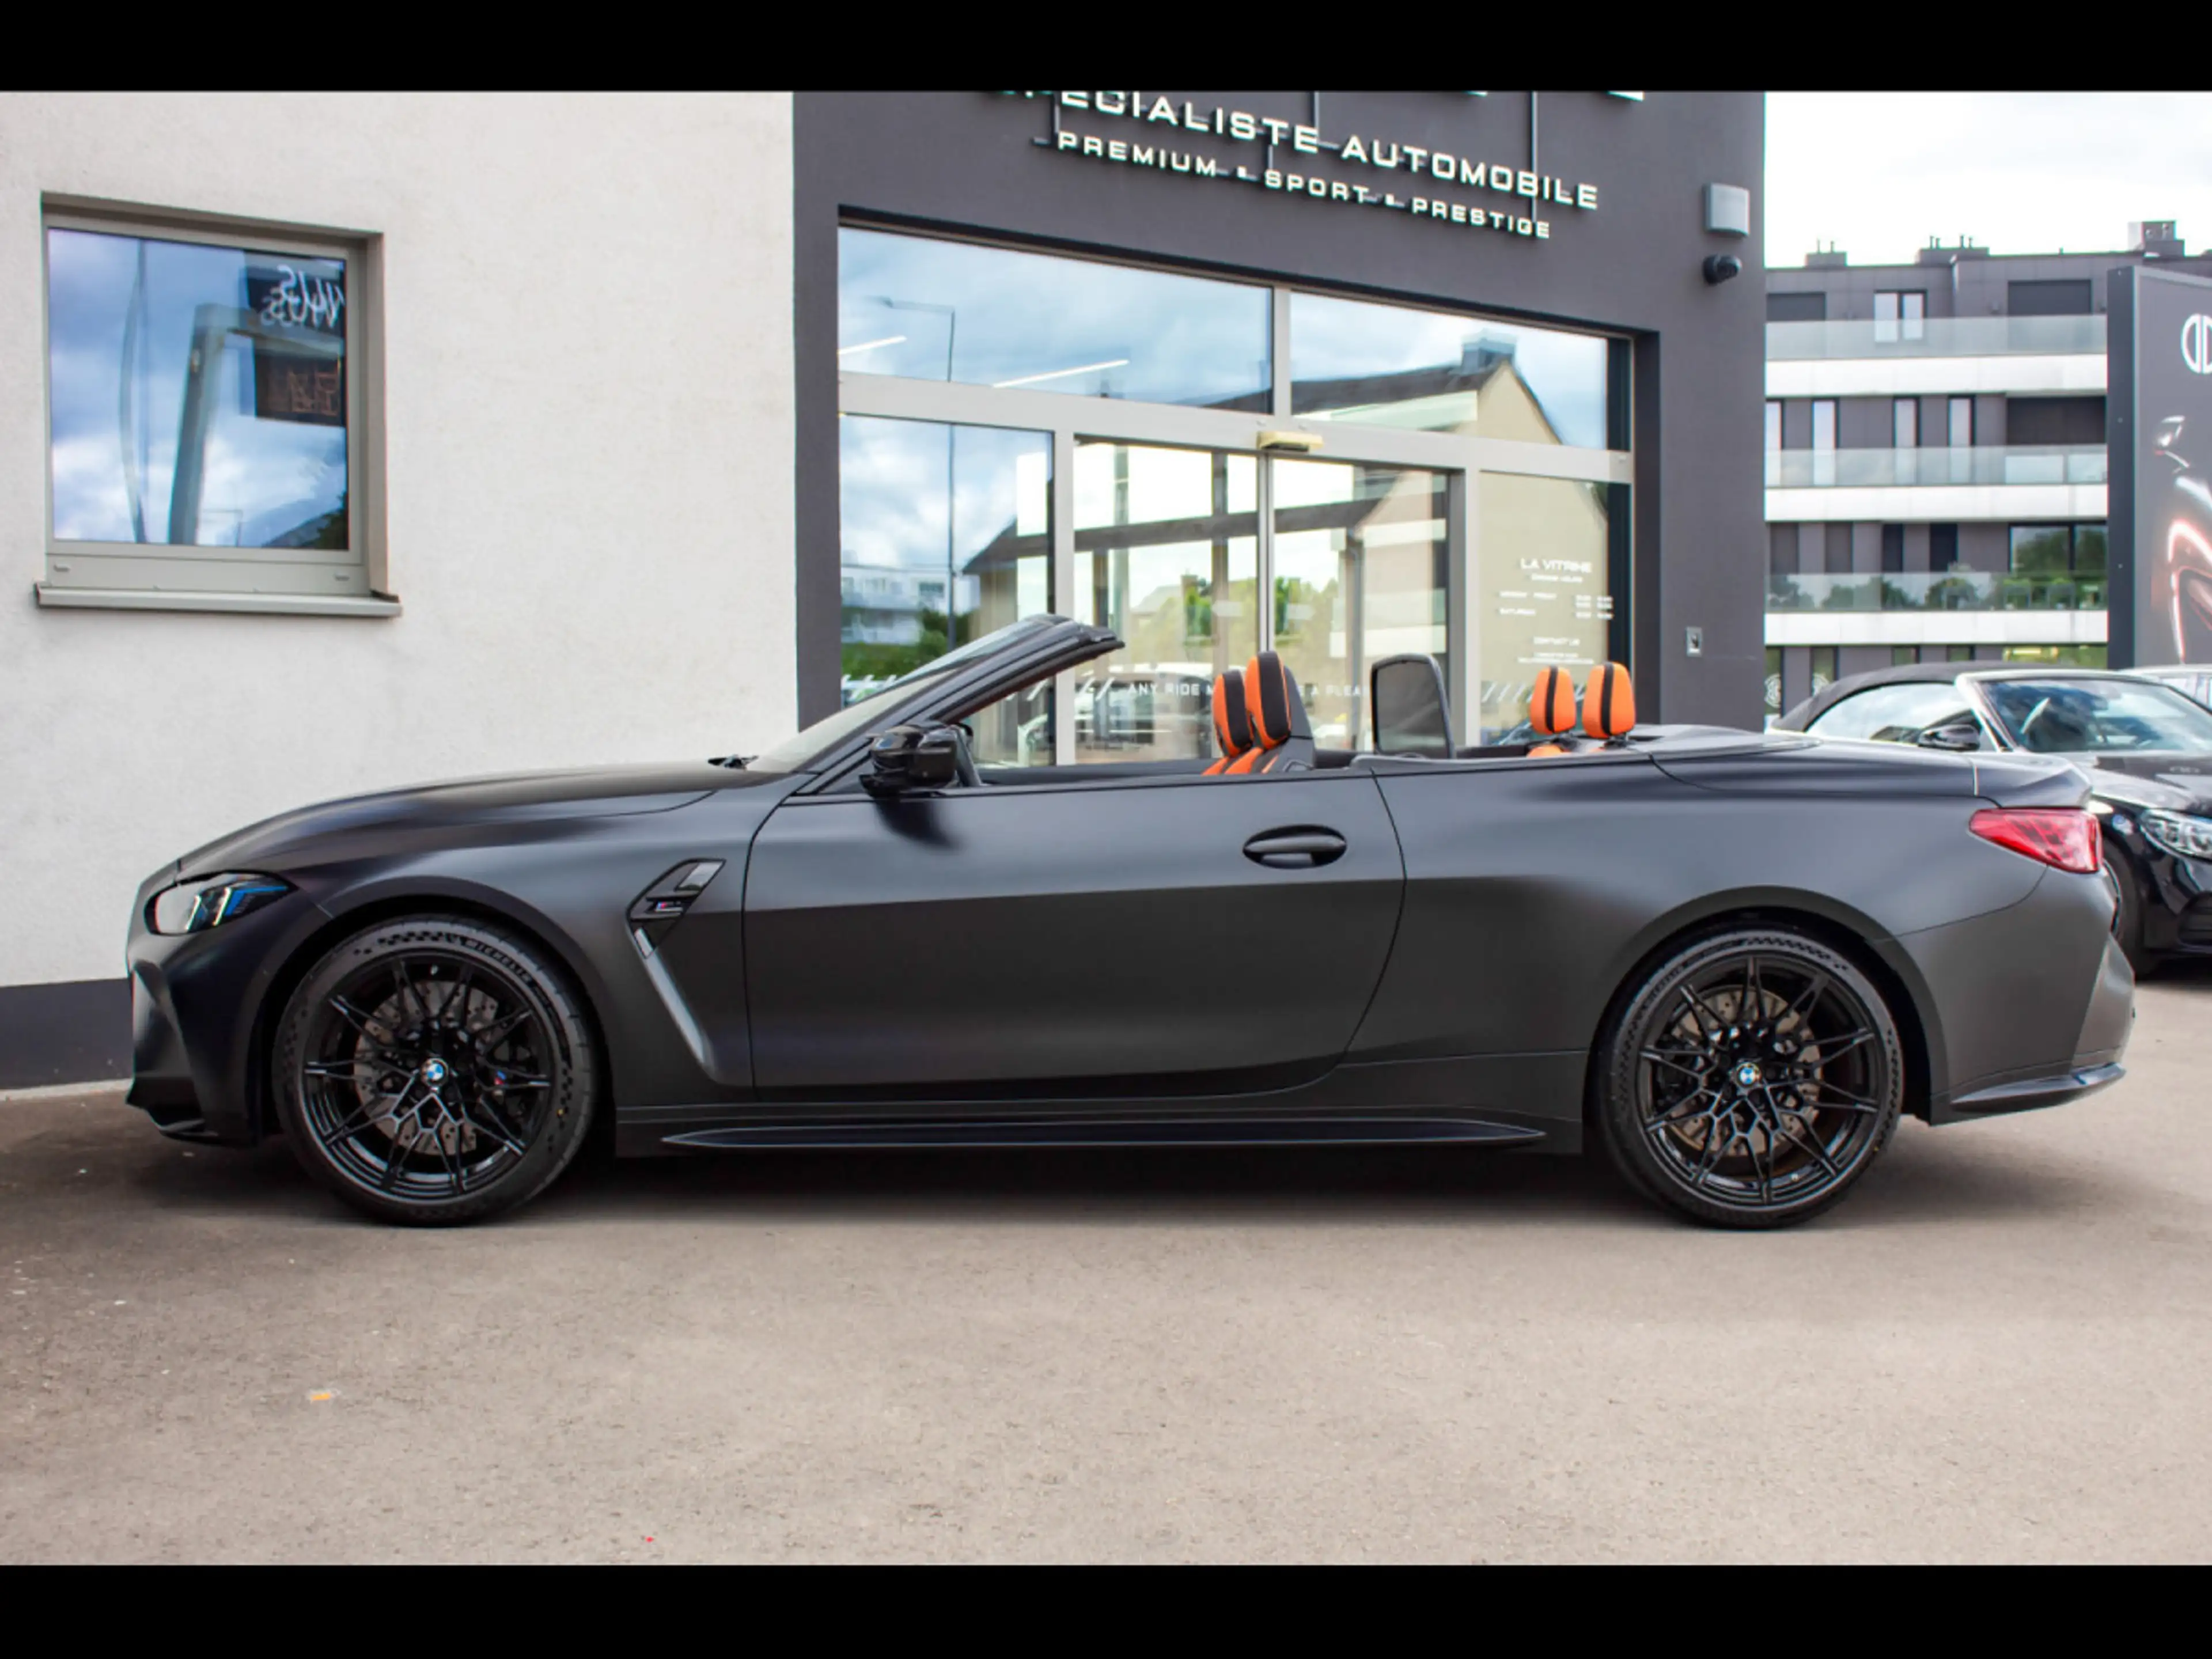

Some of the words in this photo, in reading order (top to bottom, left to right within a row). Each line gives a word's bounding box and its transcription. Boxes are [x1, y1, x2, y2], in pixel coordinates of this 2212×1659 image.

[1001, 90, 1318, 153] ECIALISTE
[1340, 134, 1598, 210] AUTOMOBILE
[1058, 130, 1216, 177] PREMIUM
[1264, 168, 1369, 203] SPORT
[1412, 196, 1550, 239] PRESTIGE
